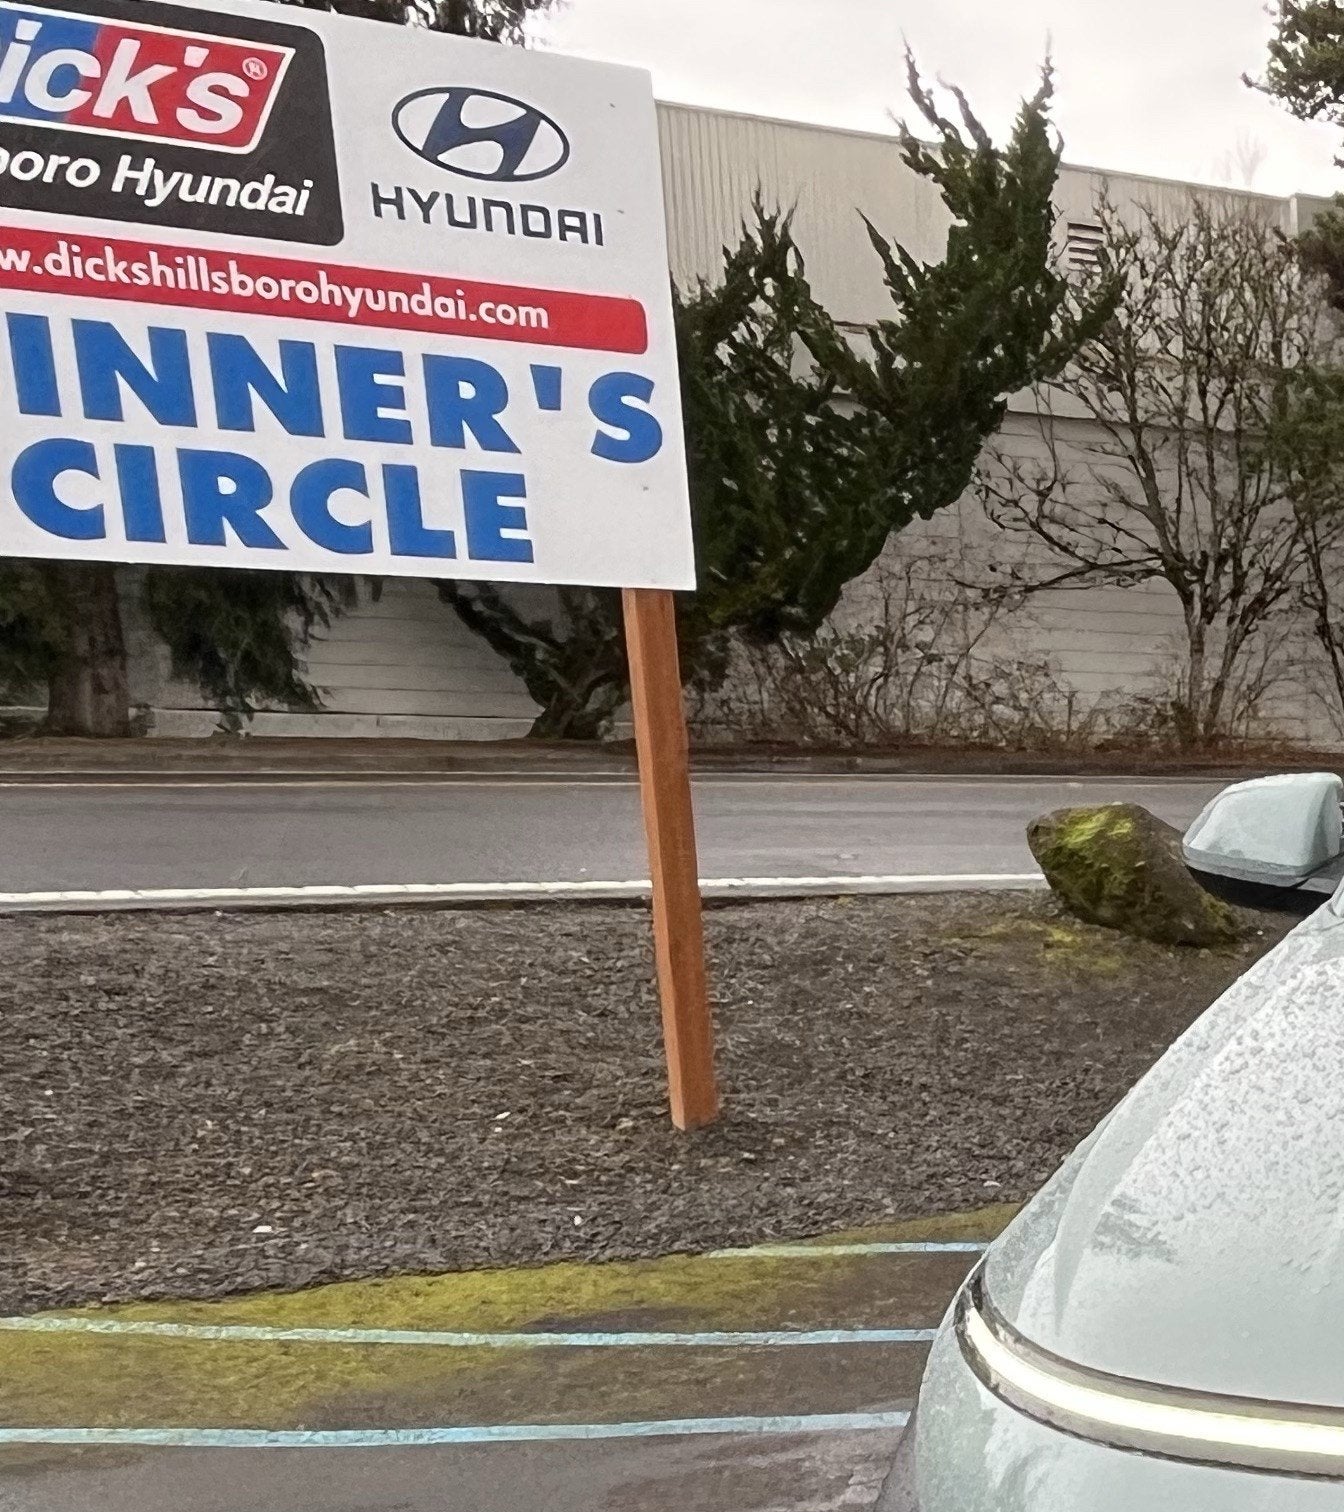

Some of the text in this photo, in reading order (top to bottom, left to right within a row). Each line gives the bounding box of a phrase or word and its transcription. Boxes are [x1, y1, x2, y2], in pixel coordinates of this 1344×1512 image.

[111, 155, 314, 216] Hyundai
[371, 182, 605, 247] HYUNDAI
[6, 311, 663, 464] INNER'S
[12, 437, 534, 563] CIRCLE
